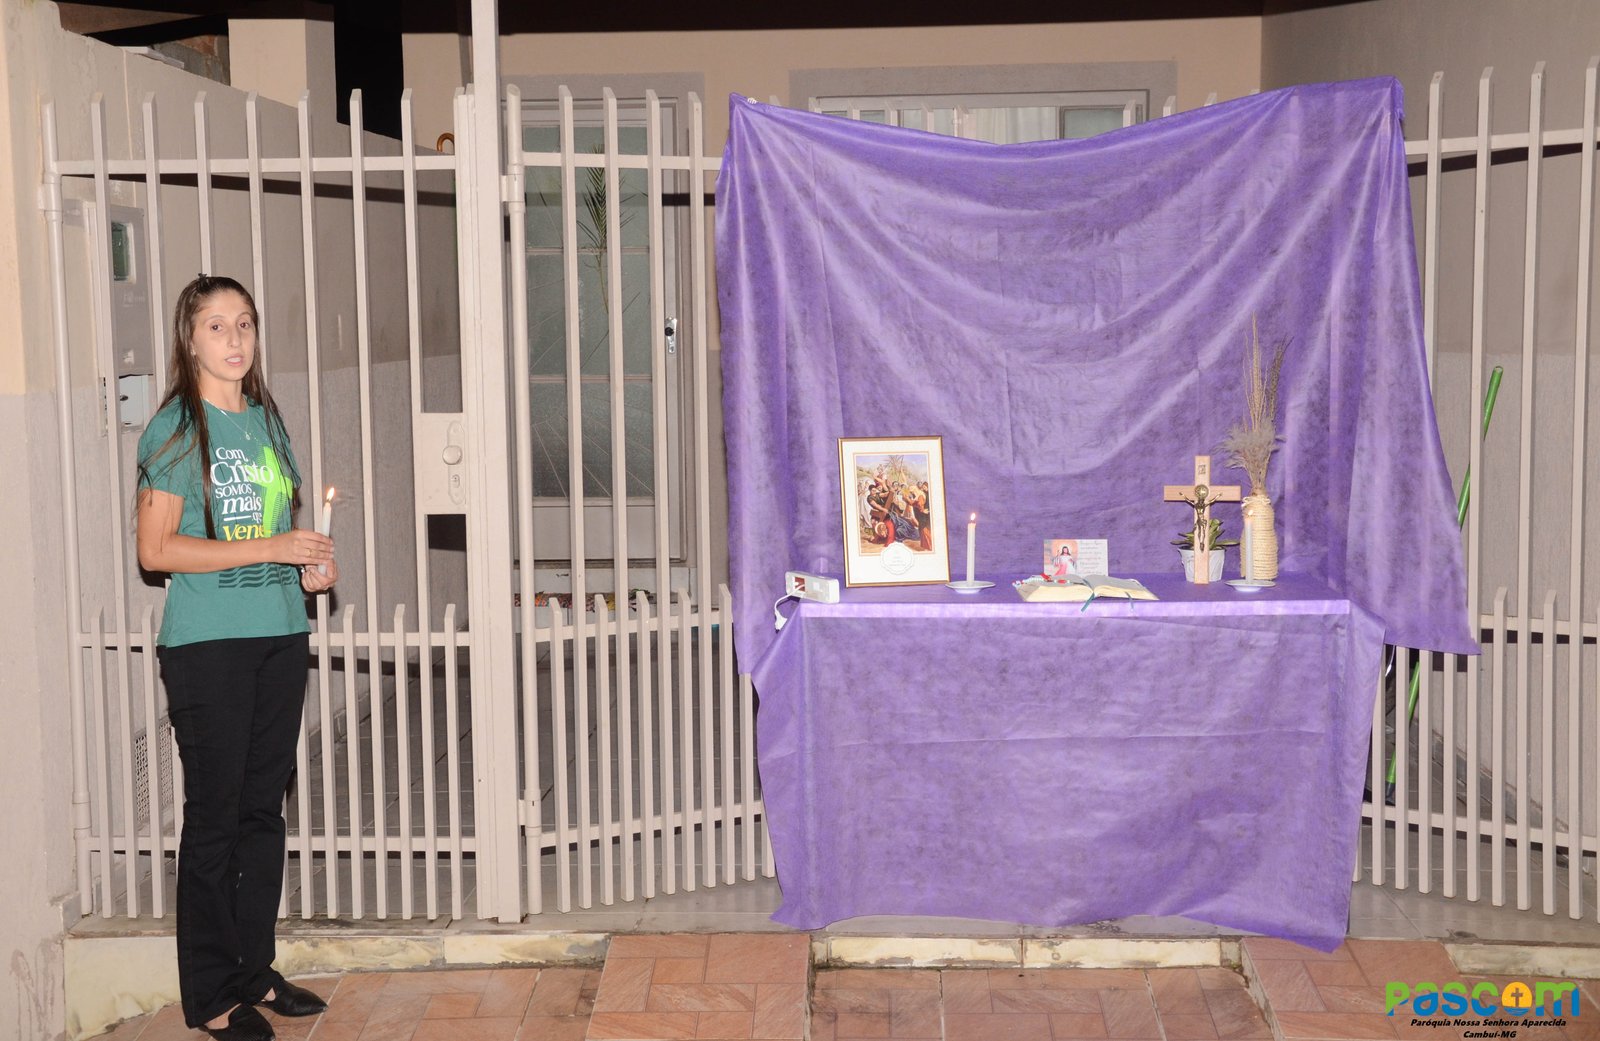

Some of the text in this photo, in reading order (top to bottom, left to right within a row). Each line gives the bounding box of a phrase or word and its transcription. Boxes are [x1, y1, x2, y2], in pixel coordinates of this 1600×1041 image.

[215, 447, 248, 461] Com
[210, 460, 274, 486] Cristo
[221, 491, 262, 514] mais
